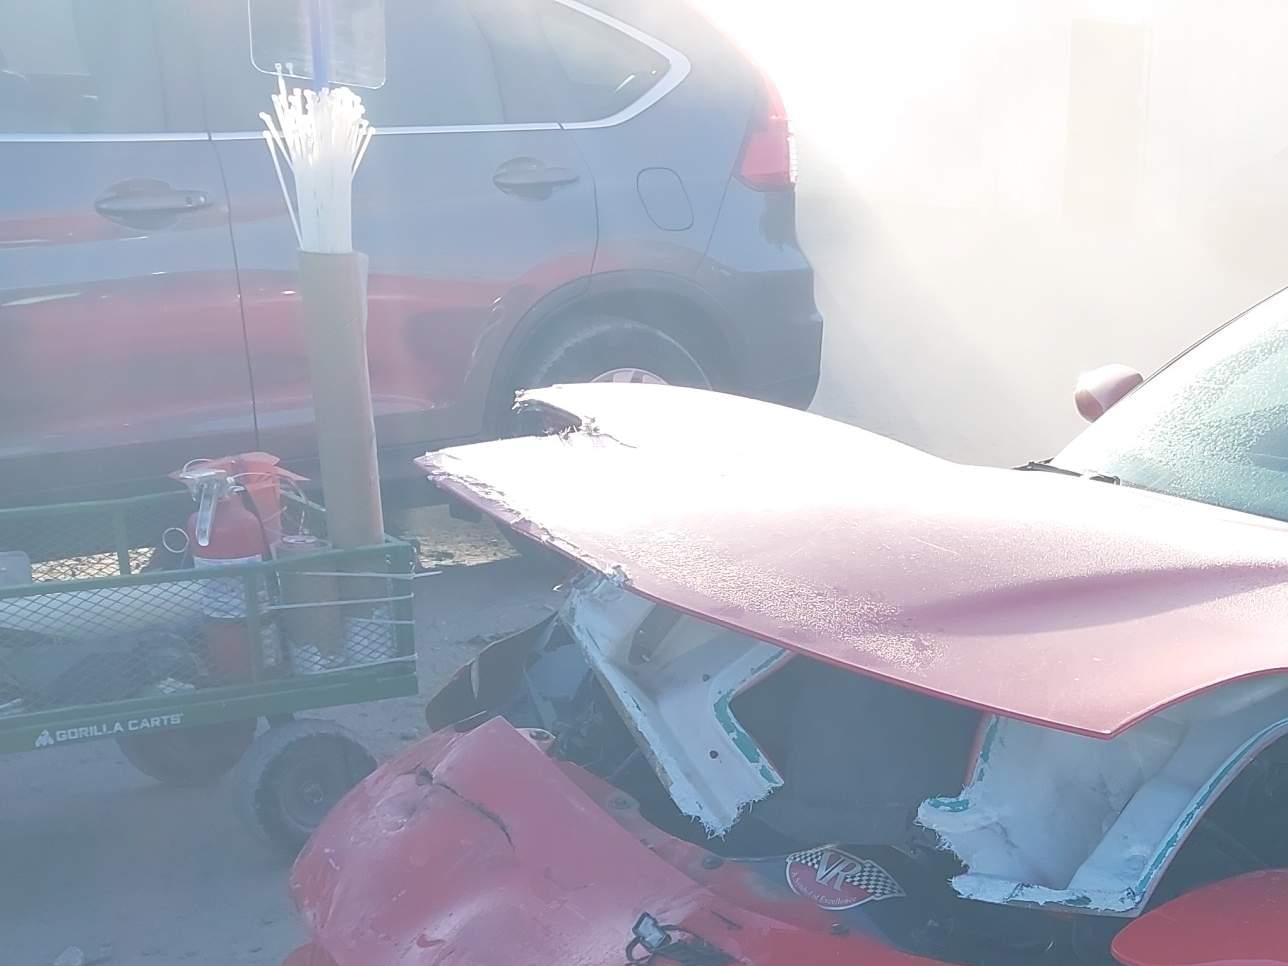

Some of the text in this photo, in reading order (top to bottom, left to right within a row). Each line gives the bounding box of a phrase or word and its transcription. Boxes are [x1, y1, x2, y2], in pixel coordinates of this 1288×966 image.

[55, 713, 182, 742] GORILLA CARTS
[815, 850, 861, 891] VR
